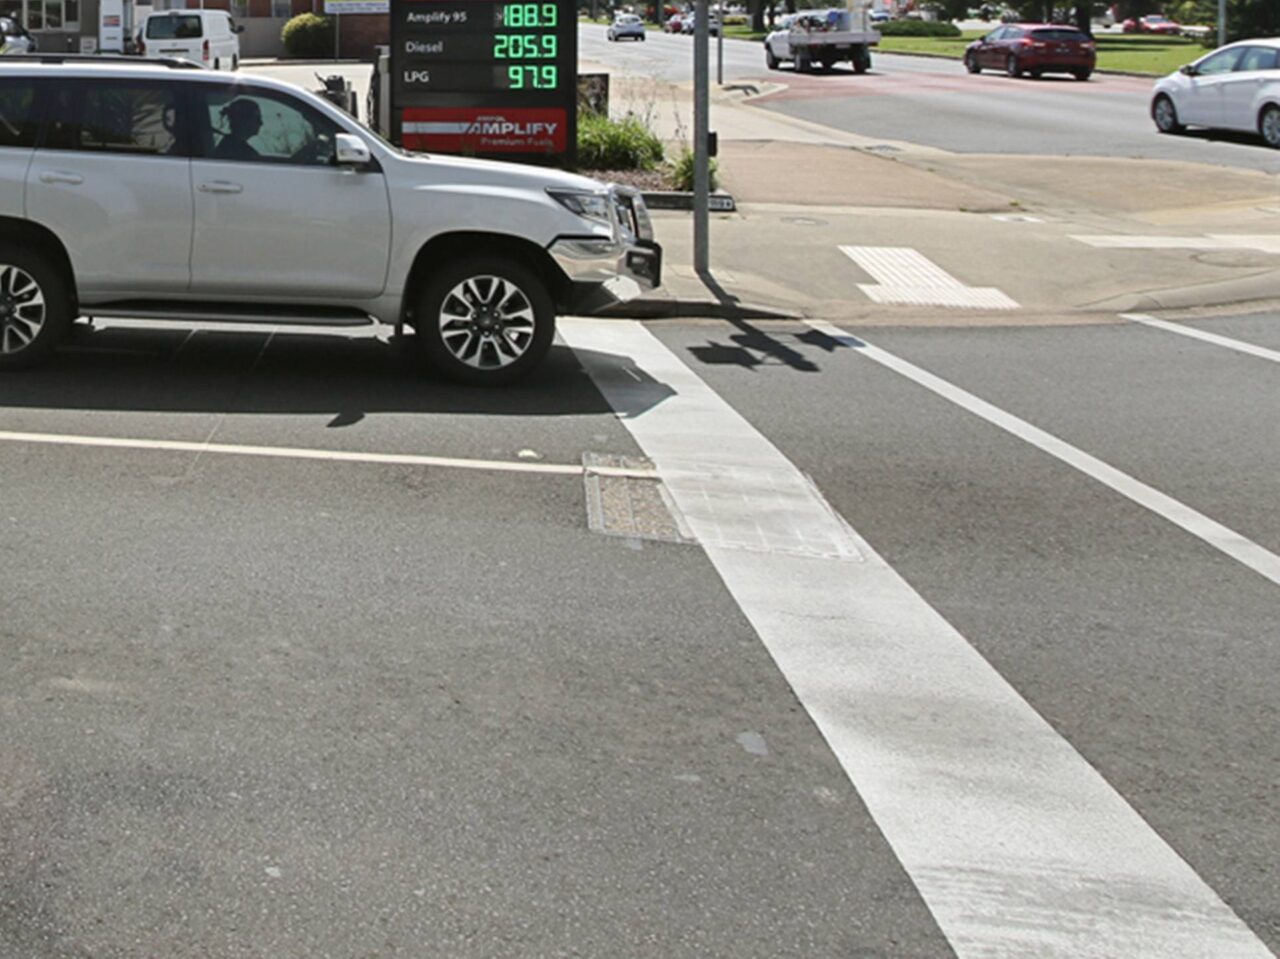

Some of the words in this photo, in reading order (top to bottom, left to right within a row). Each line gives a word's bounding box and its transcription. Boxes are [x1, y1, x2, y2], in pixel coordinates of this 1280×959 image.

[406, 11, 451, 24] Amplify
[453, 11, 467, 22] 95
[503, 4, 557, 27] 188.9
[405, 41, 443, 53] Diesel
[493, 35, 557, 58] 205.9
[404, 71, 430, 83] LPG
[508, 66, 557, 88] 97.9
[468, 122, 558, 135] AMPLIFY
[481, 137, 525, 146] Premium
